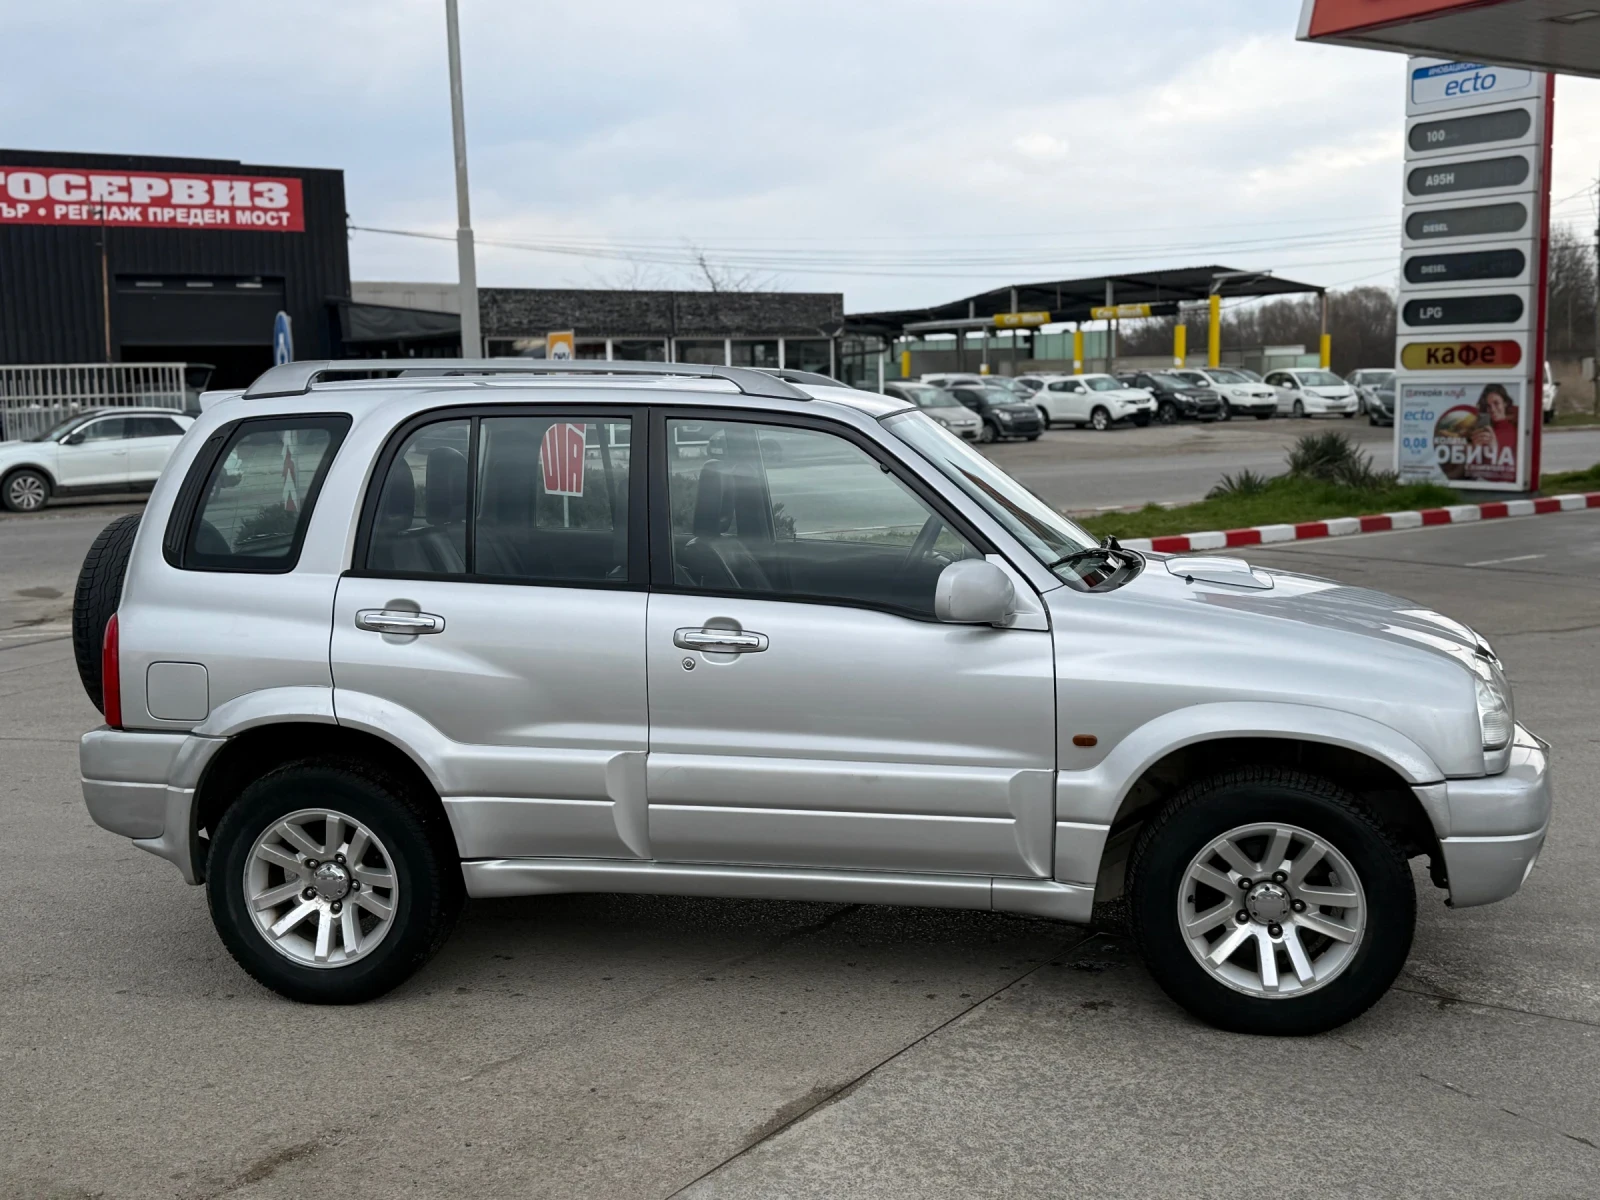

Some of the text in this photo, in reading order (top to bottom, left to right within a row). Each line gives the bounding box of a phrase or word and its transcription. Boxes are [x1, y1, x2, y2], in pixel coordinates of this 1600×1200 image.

[1445, 71, 1496, 96] ecto
[1426, 129, 1445, 143] 100
[0, 171, 289, 209] ОСЕРВИЗ
[147, 206, 230, 226] ПРЕДЕН
[235, 210, 291, 227] МОСТ
[1422, 223, 1448, 233] DIESEL
[1420, 264, 1447, 274] DIESEL
[1419, 306, 1443, 319] LPG
[1426, 344, 1496, 366] кафе
[1404, 408, 1435, 421] ecto
[1402, 437, 1428, 449] 0,08
[1435, 445, 1515, 466] ОБИЧА
